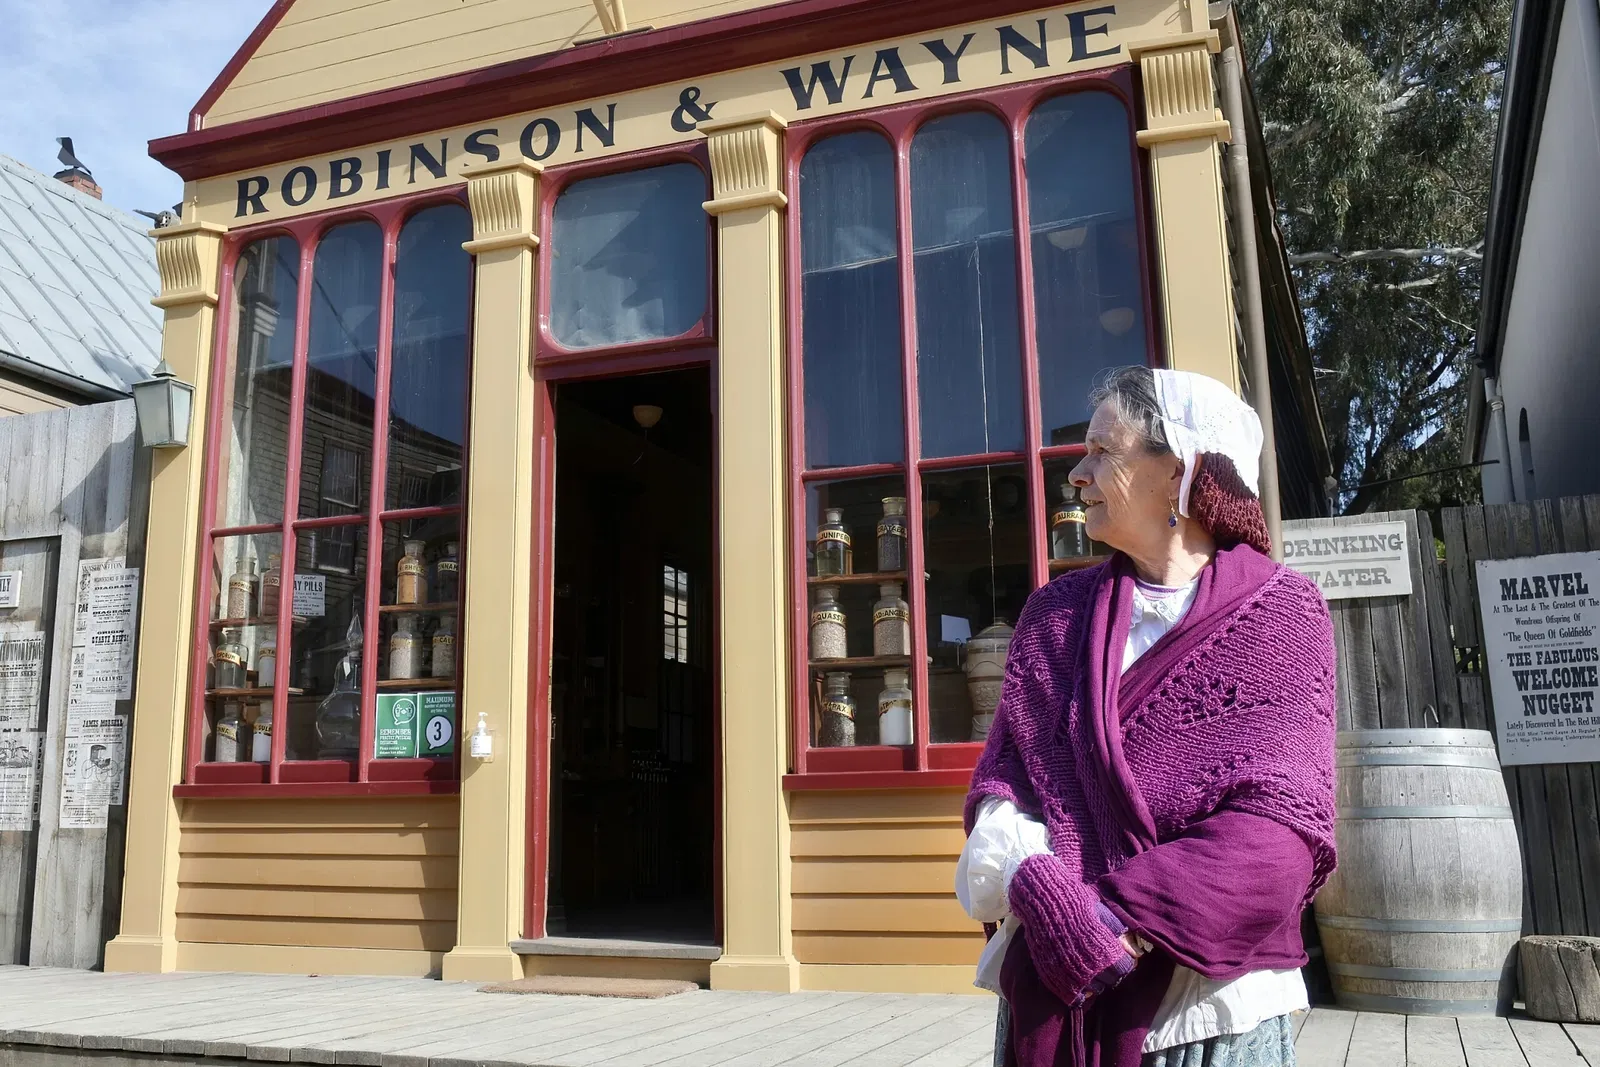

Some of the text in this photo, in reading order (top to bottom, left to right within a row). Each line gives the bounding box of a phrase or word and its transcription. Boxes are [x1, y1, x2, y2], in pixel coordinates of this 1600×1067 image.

[235, 5, 1121, 218] ROBINSON & WAYNE
[1284, 533, 1404, 557] DRINKING
[304, 581, 323, 592] PILLS
[1499, 572, 1589, 601] MARVEL
[1493, 597, 1600, 613] At The Last & The Greatest Of The
[1515, 612, 1581, 626] Wondrous Offspring Of
[1524, 630, 1546, 642] Queen
[1548, 628, 1556, 639] Of
[1507, 647, 1599, 667] THE FABULOUS
[1512, 666, 1599, 692] WELCOME
[1522, 691, 1594, 716] NUGGET
[434, 721, 442, 741] 3
[1506, 720, 1524, 730] Lately
[1525, 718, 1556, 729] Discovered
[1558, 718, 1564, 727] In
[1565, 717, 1577, 727] The
[1578, 716, 1590, 726] Red
